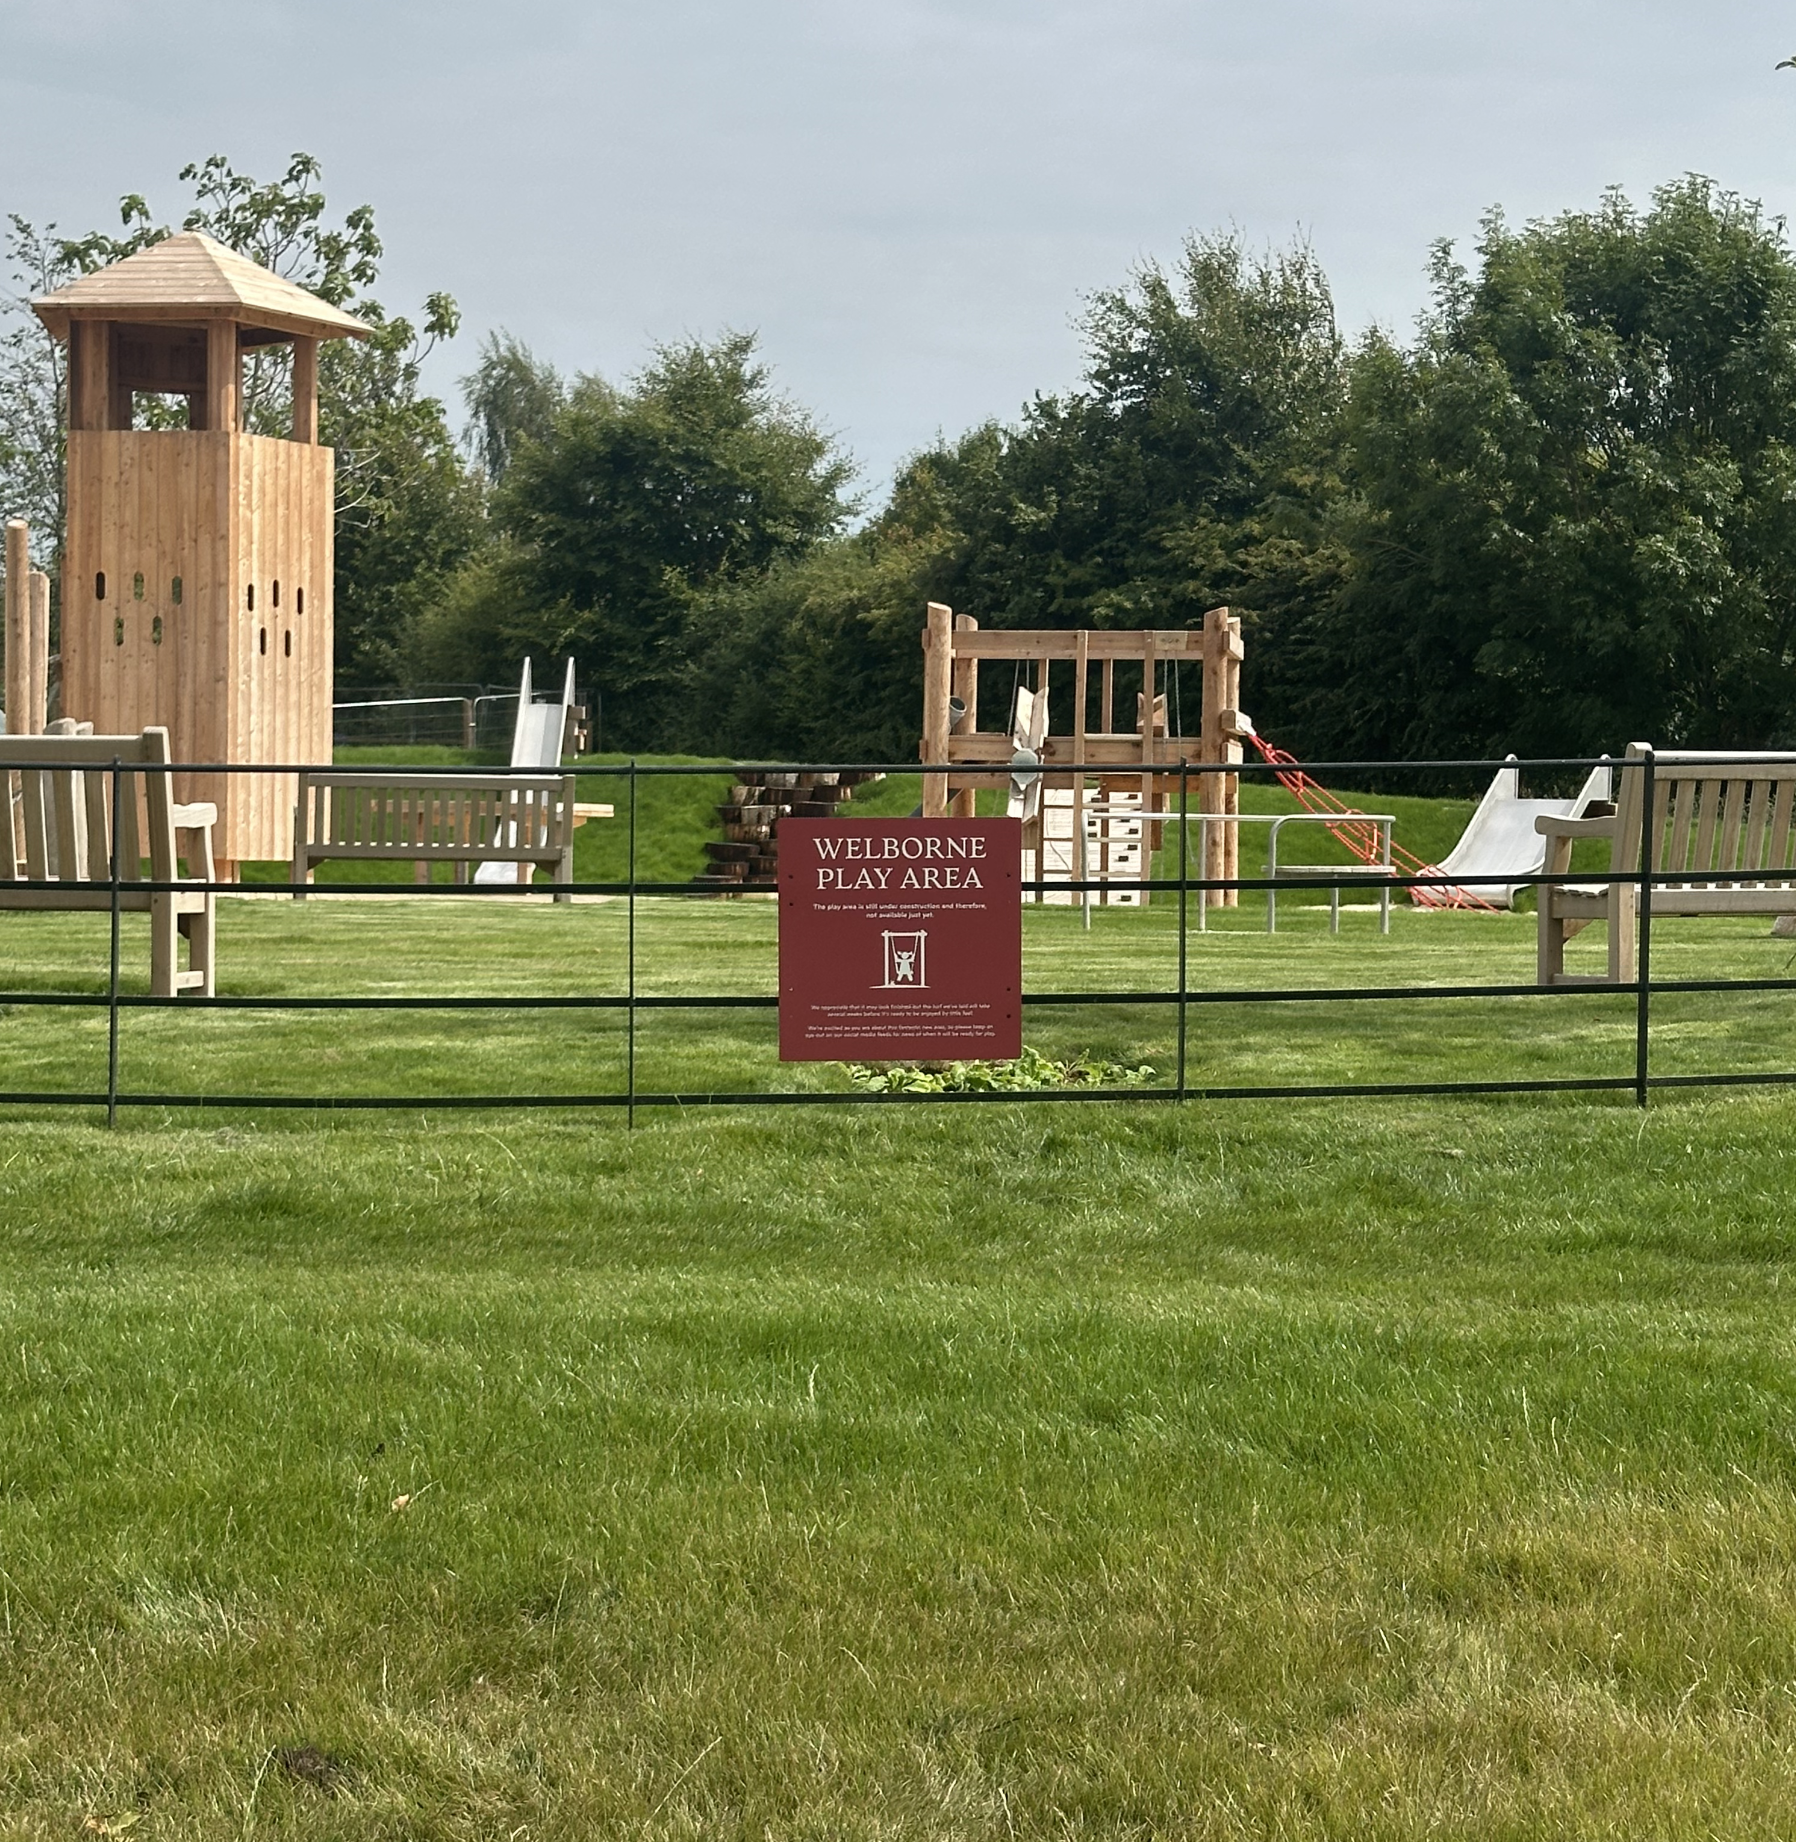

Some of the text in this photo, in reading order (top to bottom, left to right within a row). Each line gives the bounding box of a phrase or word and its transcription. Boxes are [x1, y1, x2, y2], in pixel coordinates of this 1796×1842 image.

[813, 837, 986, 859] WELBORNE
[817, 867, 983, 889] PLAY AREA
